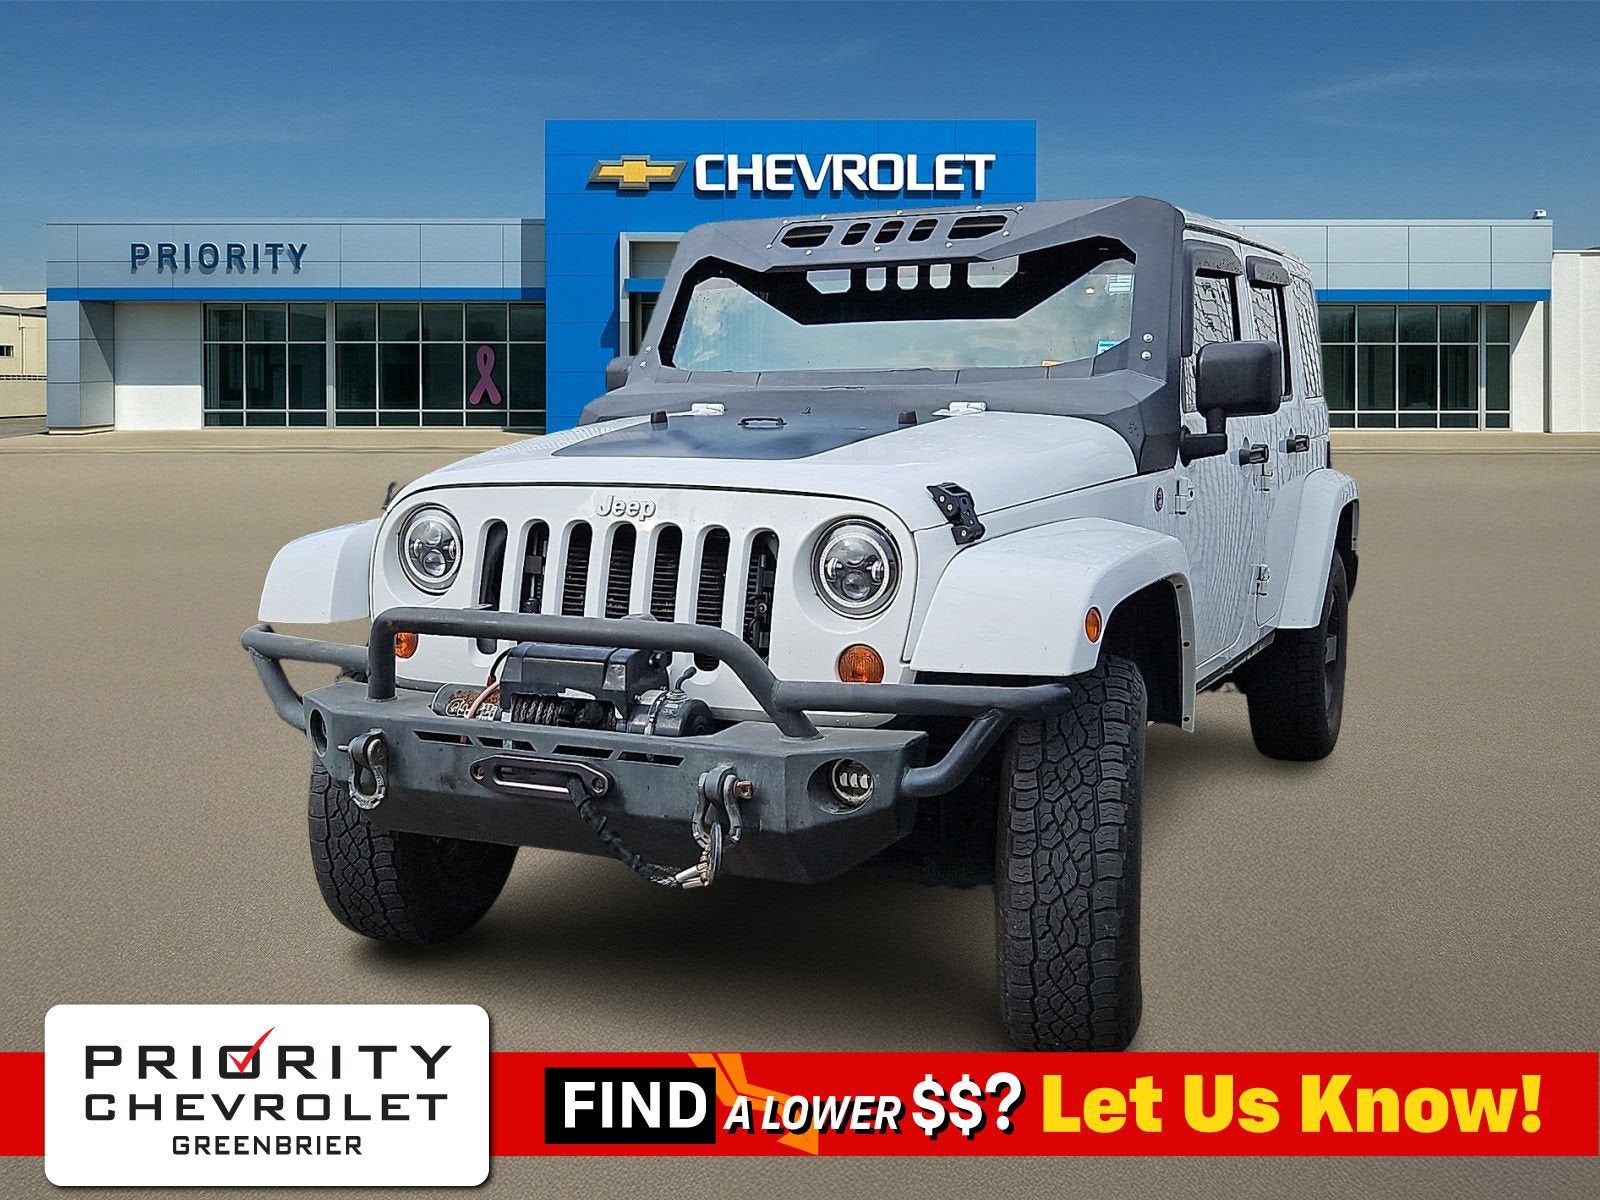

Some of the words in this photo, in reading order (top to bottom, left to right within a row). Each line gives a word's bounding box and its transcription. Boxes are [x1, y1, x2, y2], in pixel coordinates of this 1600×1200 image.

[694, 153, 996, 191] CHEVROLET
[130, 242, 308, 271] PRIORITY
[596, 494, 657, 521] Jeep
